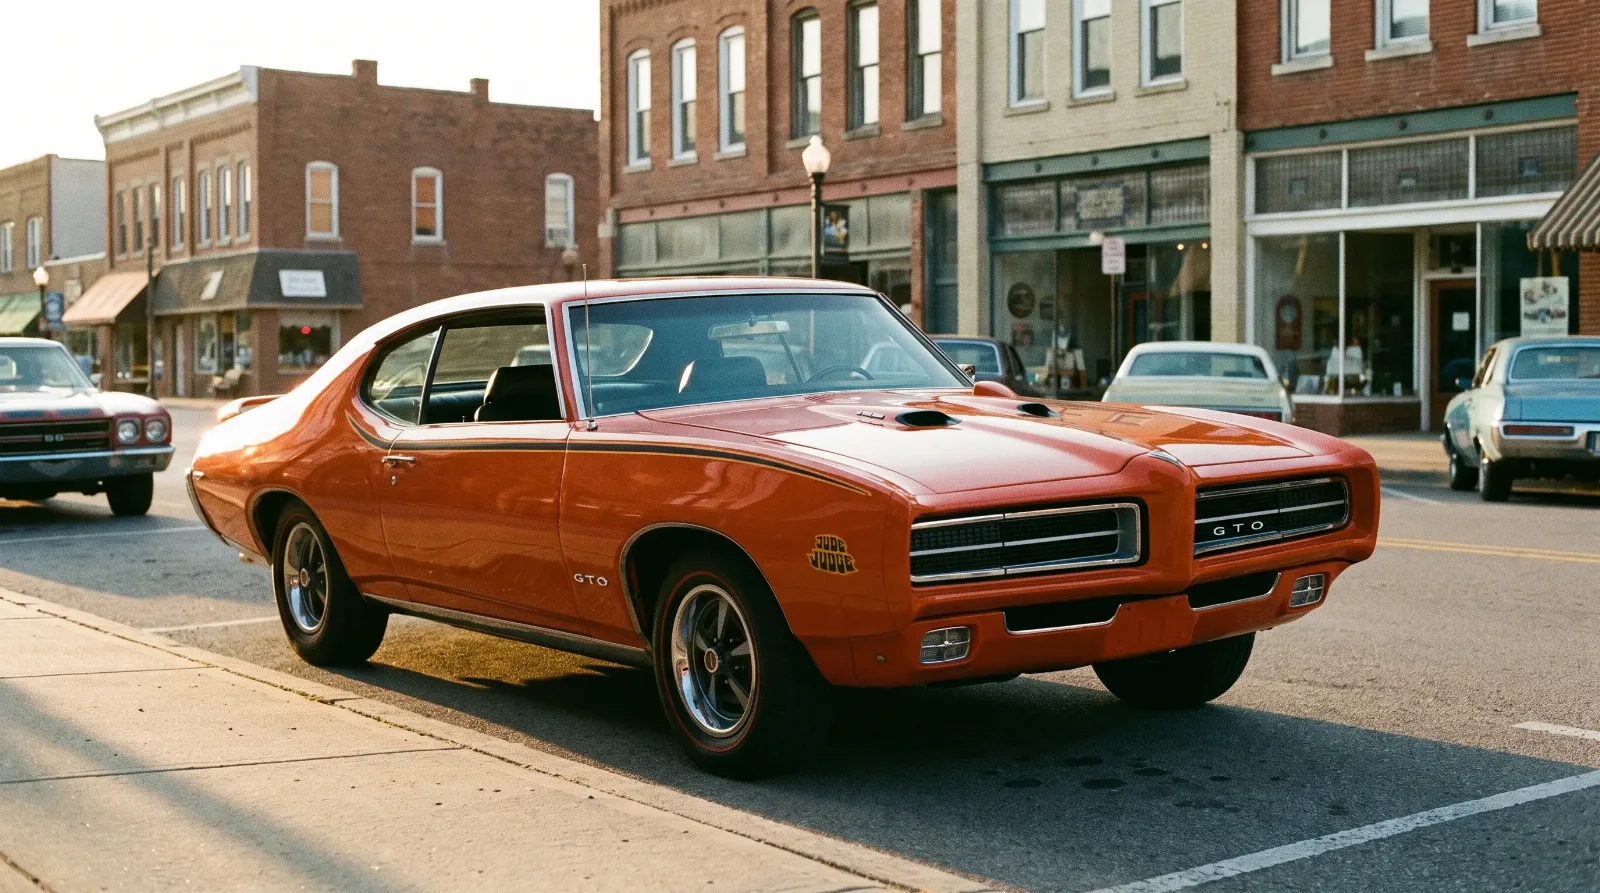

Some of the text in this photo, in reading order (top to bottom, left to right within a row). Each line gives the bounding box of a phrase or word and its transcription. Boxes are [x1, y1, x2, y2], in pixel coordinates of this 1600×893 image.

[1213, 521, 1264, 536] GTO
[807, 550, 857, 575] JUDGE
[573, 573, 608, 586] GTO
